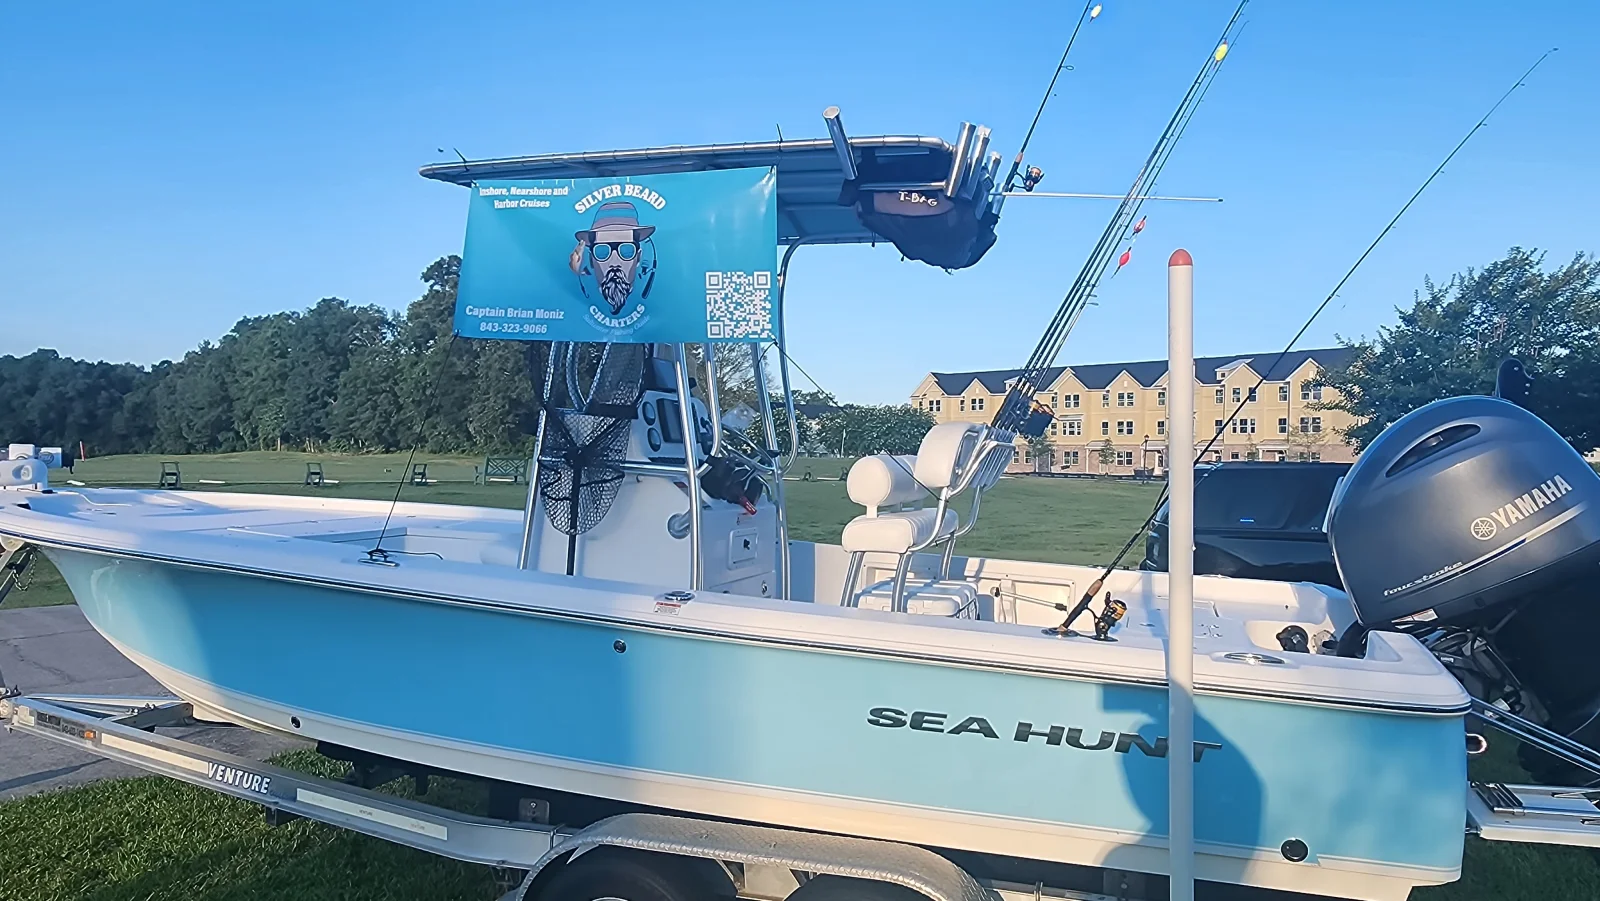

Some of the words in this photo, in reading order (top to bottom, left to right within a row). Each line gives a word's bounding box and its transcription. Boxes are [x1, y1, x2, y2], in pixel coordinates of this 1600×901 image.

[479, 186, 509, 196] Inshore,
[510, 186, 552, 196] Nearshore
[553, 186, 569, 196] and
[574, 184, 622, 214] SILVER
[624, 184, 667, 210] BEARD
[898, 191, 938, 207] T-BAG
[493, 199, 519, 209] Harbor
[519, 199, 551, 208] Cruises
[465, 305, 505, 318] Captain
[507, 307, 533, 318] Brian
[535, 308, 565, 319] Moniz
[589, 303, 646, 328] CHARTERS
[480, 322, 548, 334] 843-323-9066
[1490, 474, 1573, 529] YAMAHA
[867, 707, 1000, 740] SEA
[208, 762, 271, 794] VENTURE
